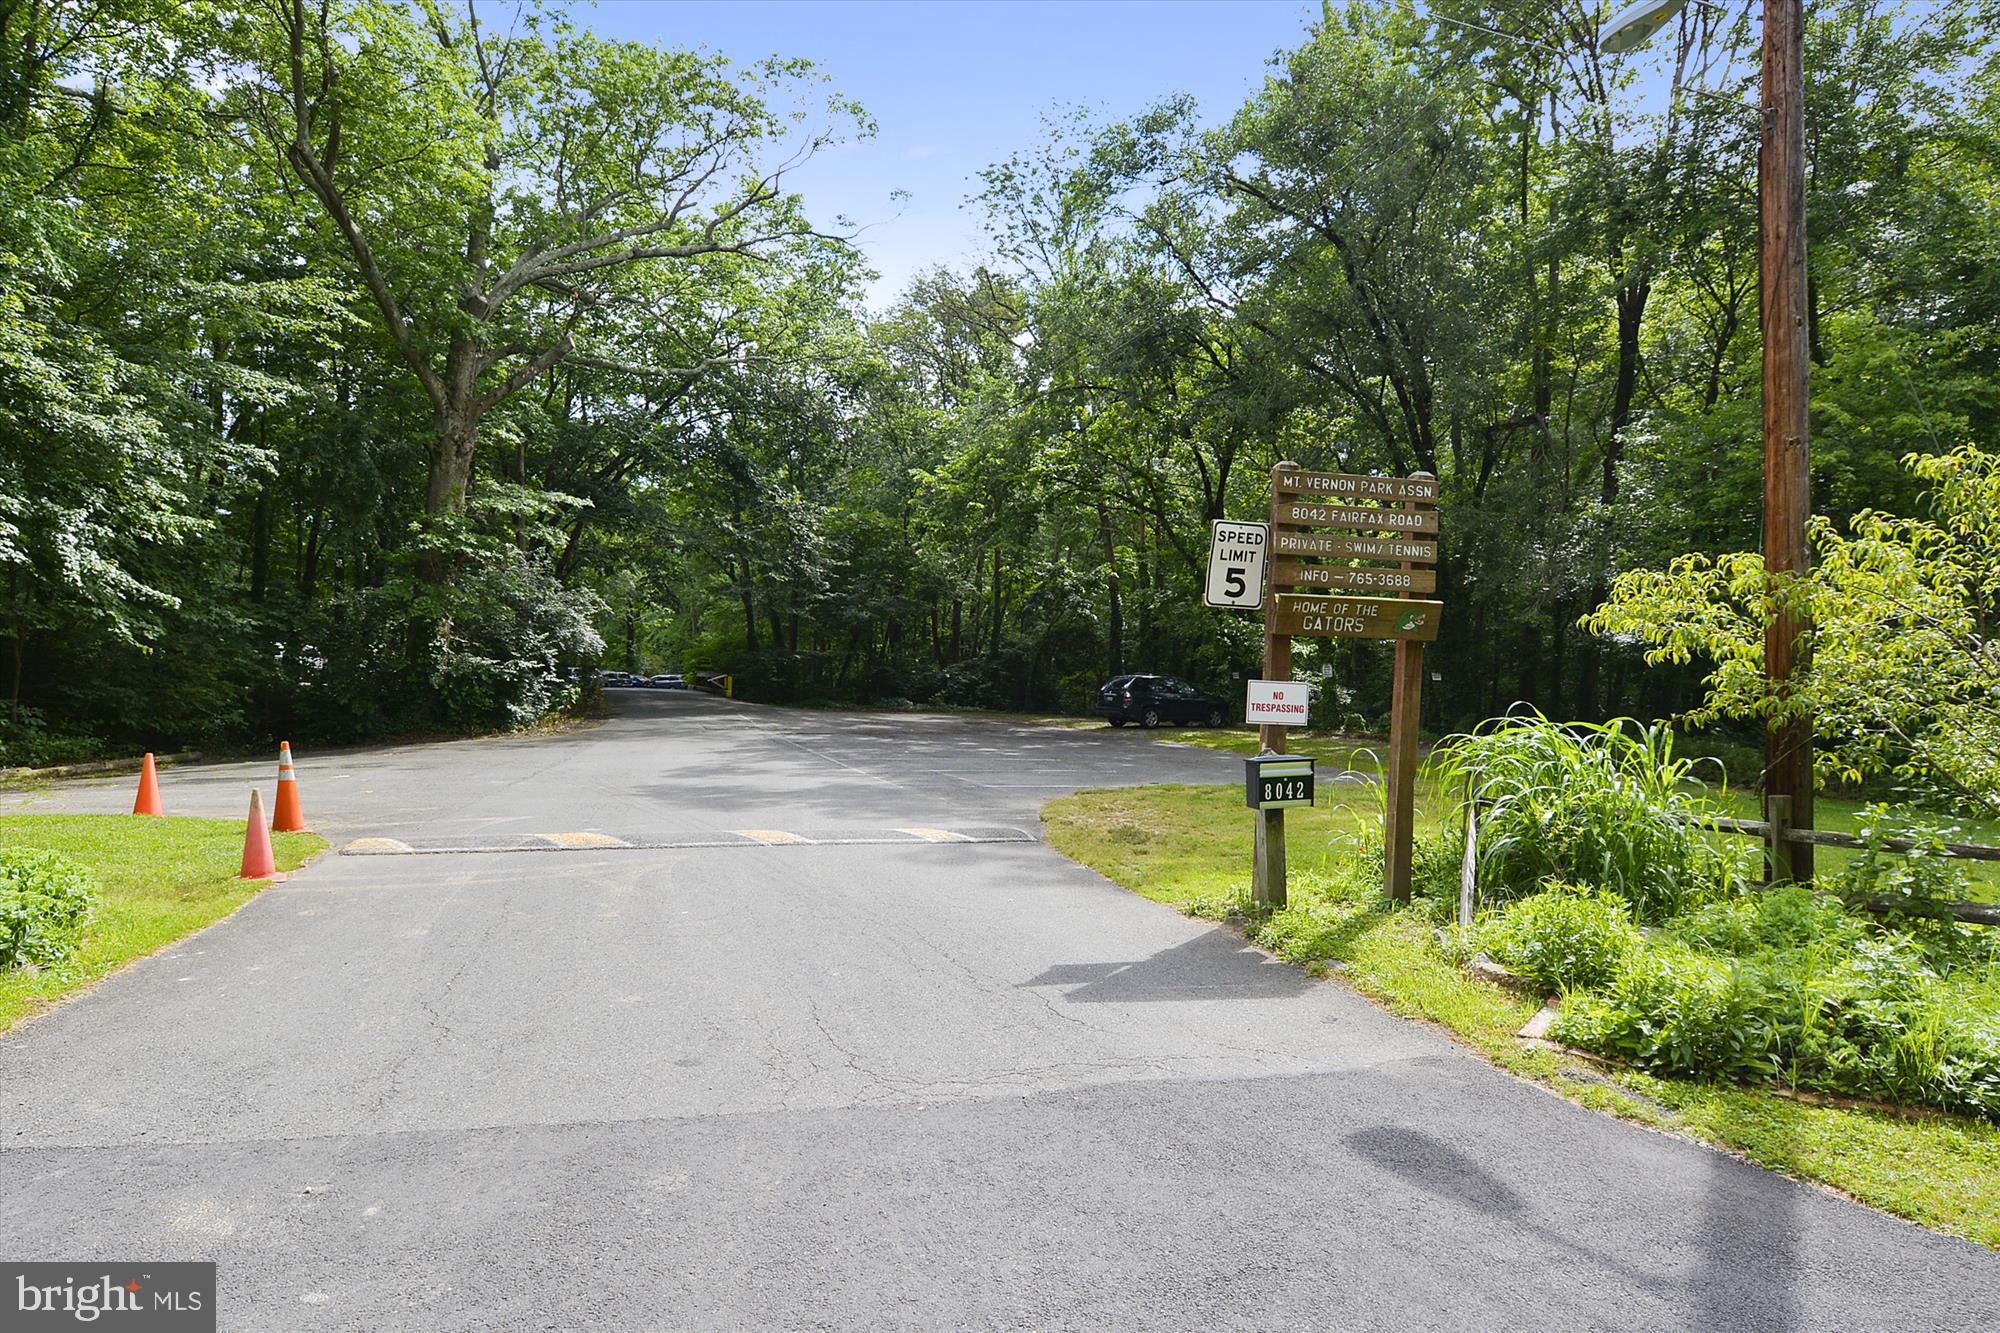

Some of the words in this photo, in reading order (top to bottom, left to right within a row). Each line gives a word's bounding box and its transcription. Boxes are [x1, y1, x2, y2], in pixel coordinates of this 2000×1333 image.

[1283, 476, 1302, 488] MT.
[1306, 476, 1355, 492] VERNON
[1360, 480, 1393, 495] PARK
[1398, 484, 1435, 499] ASSN.
[1291, 507, 1327, 521] 8042
[1331, 510, 1384, 525] FAIRFAX
[1389, 513, 1423, 527] ROAD
[1218, 530, 1264, 545] SPEED
[1280, 537, 1333, 552] PRIVATE
[1220, 548, 1257, 563] LIMIT
[1224, 567, 1246, 598] 5
[1300, 569, 1329, 583] INFO
[1349, 572, 1411, 587] 765-3688
[1292, 601, 1328, 614] HOME
[1333, 603, 1350, 615] OF
[1355, 604, 1379, 617] THE
[1302, 616, 1365, 632] GATORS
[1272, 691, 1284, 700] NO
[1251, 702, 1305, 714] TRESPASSING
[1264, 781, 1304, 800] 8042
